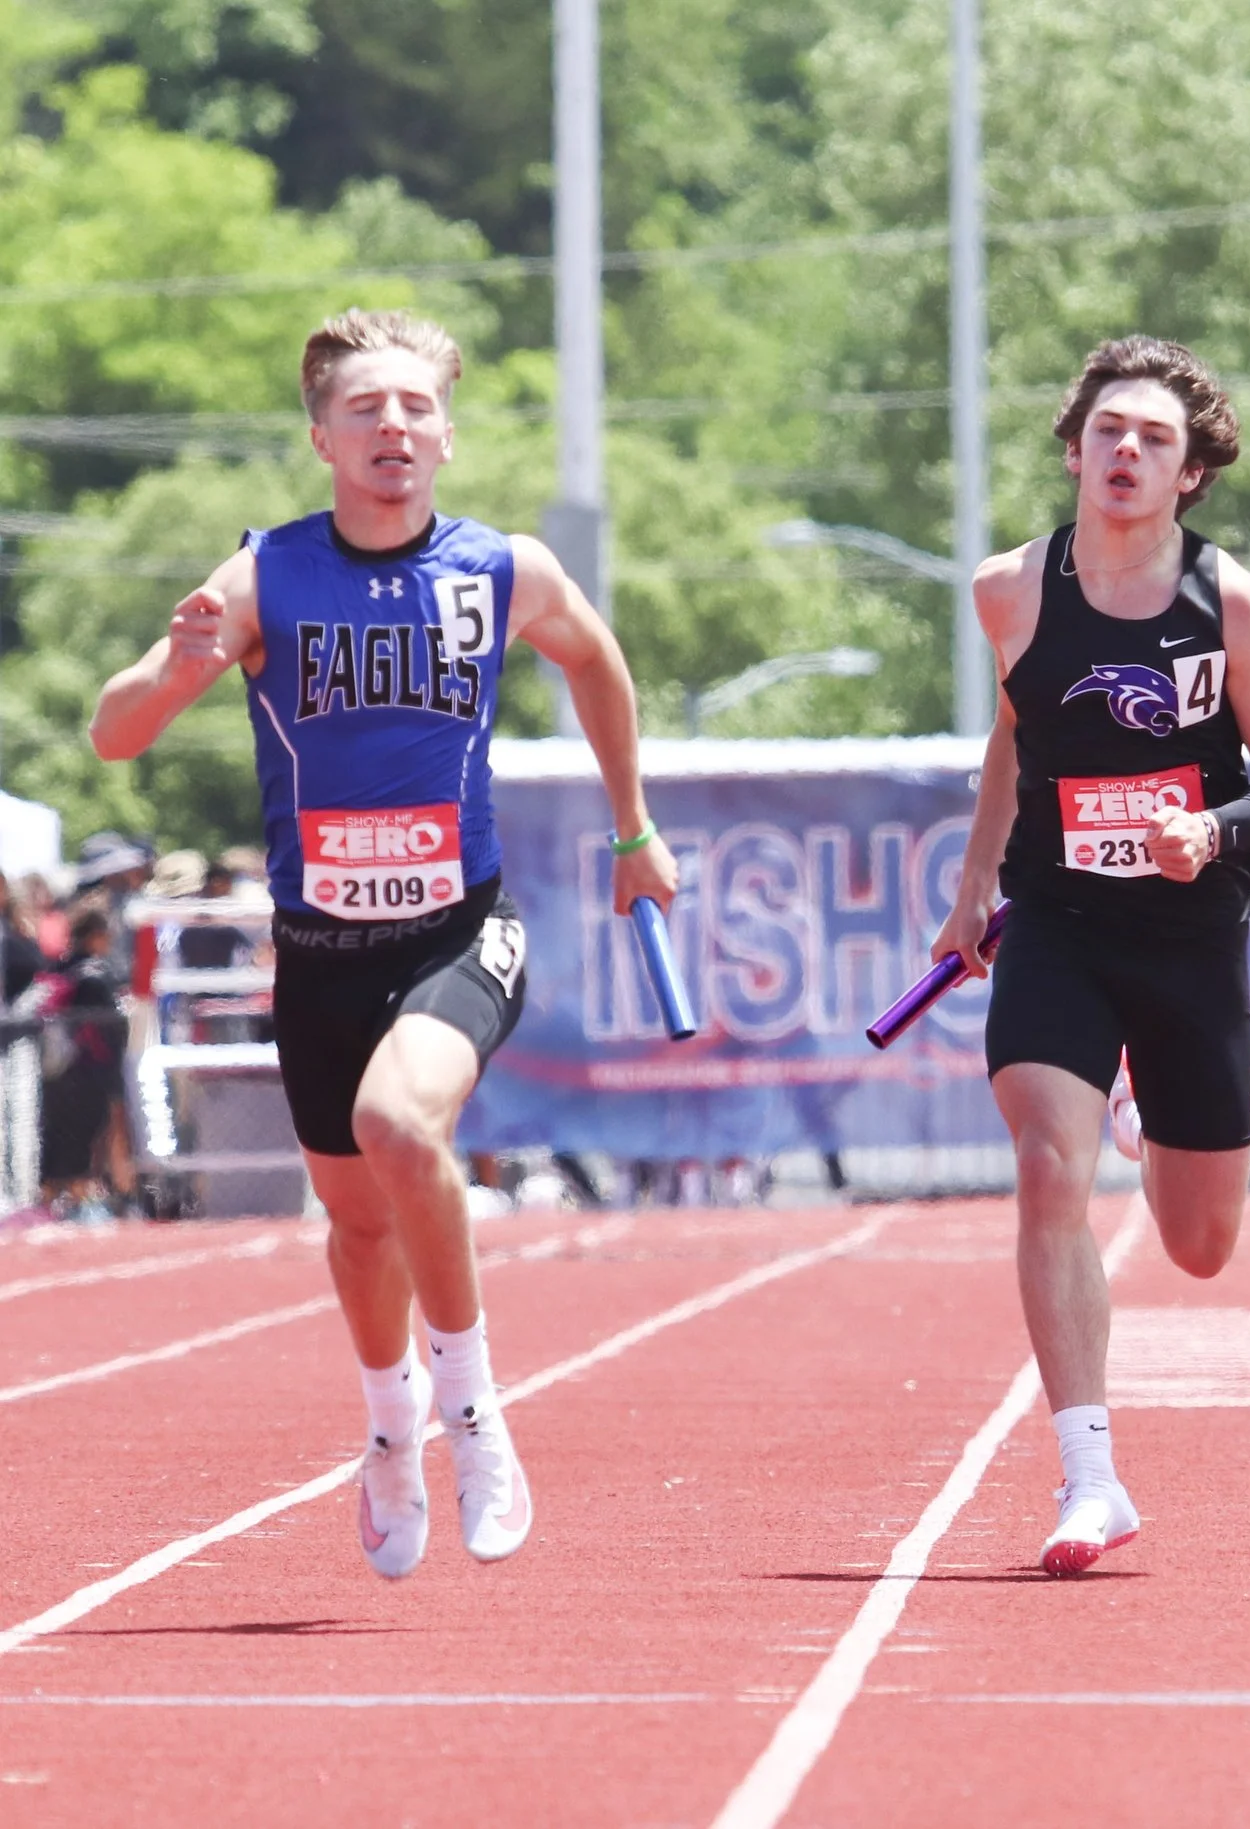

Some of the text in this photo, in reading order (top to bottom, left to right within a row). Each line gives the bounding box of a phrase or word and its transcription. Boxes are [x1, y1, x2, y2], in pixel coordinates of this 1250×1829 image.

[452, 583, 483, 652] 5
[294, 621, 480, 722] EAGLES
[1187, 659, 1216, 716] 4
[1074, 785, 1187, 822] ZERO
[1098, 778, 1160, 793] SHOW-ME
[318, 821, 443, 859] ZERO
[1100, 839, 1153, 867] 231
[343, 877, 424, 907] 2109
[280, 923, 362, 949] NIKE
